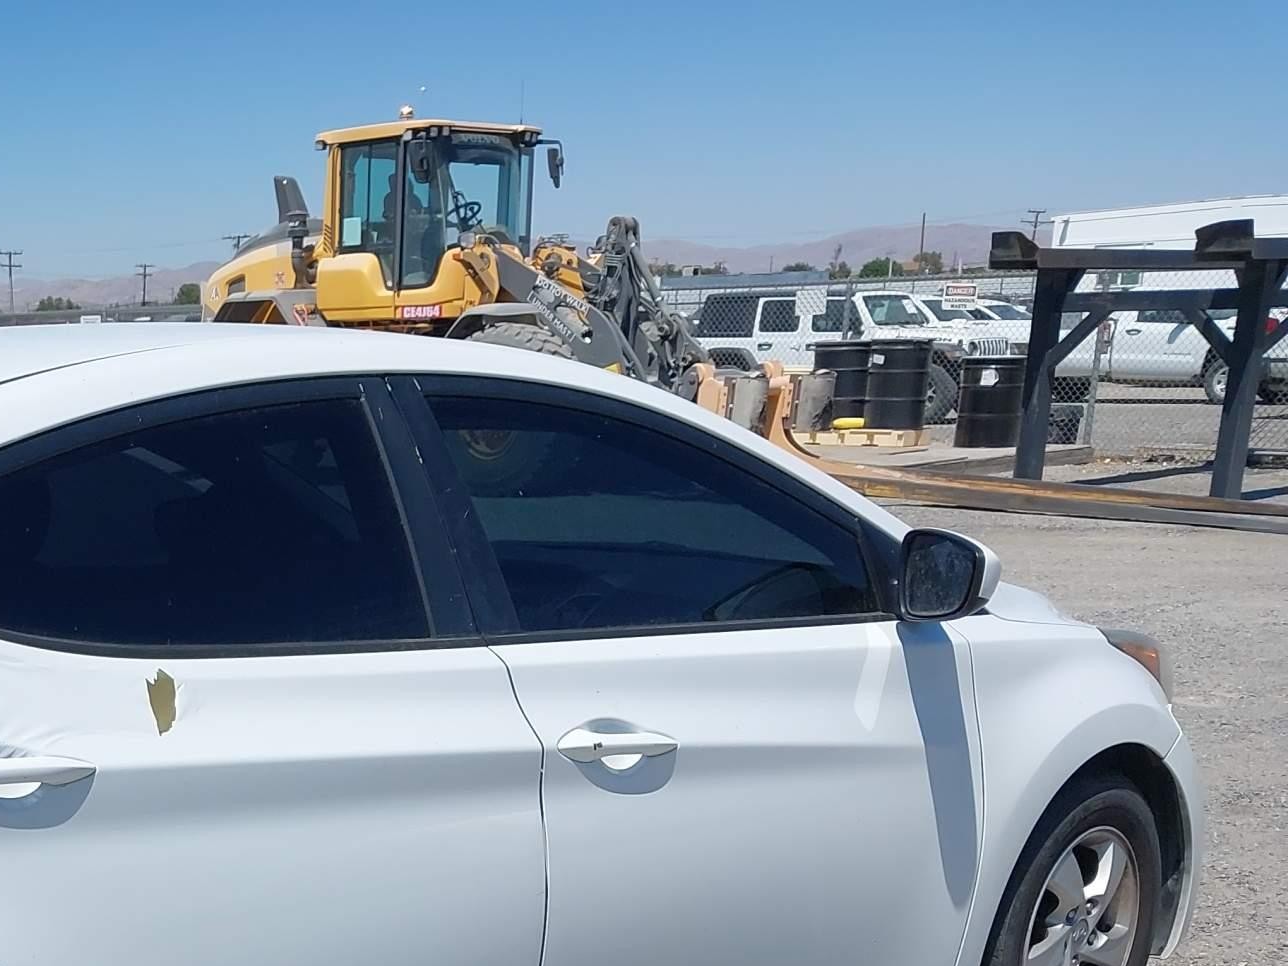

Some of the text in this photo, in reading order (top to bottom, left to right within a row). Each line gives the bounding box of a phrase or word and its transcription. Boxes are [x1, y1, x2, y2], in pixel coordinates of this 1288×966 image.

[532, 297, 572, 337] UNDER MAST
[566, 295, 589, 312] WALK
